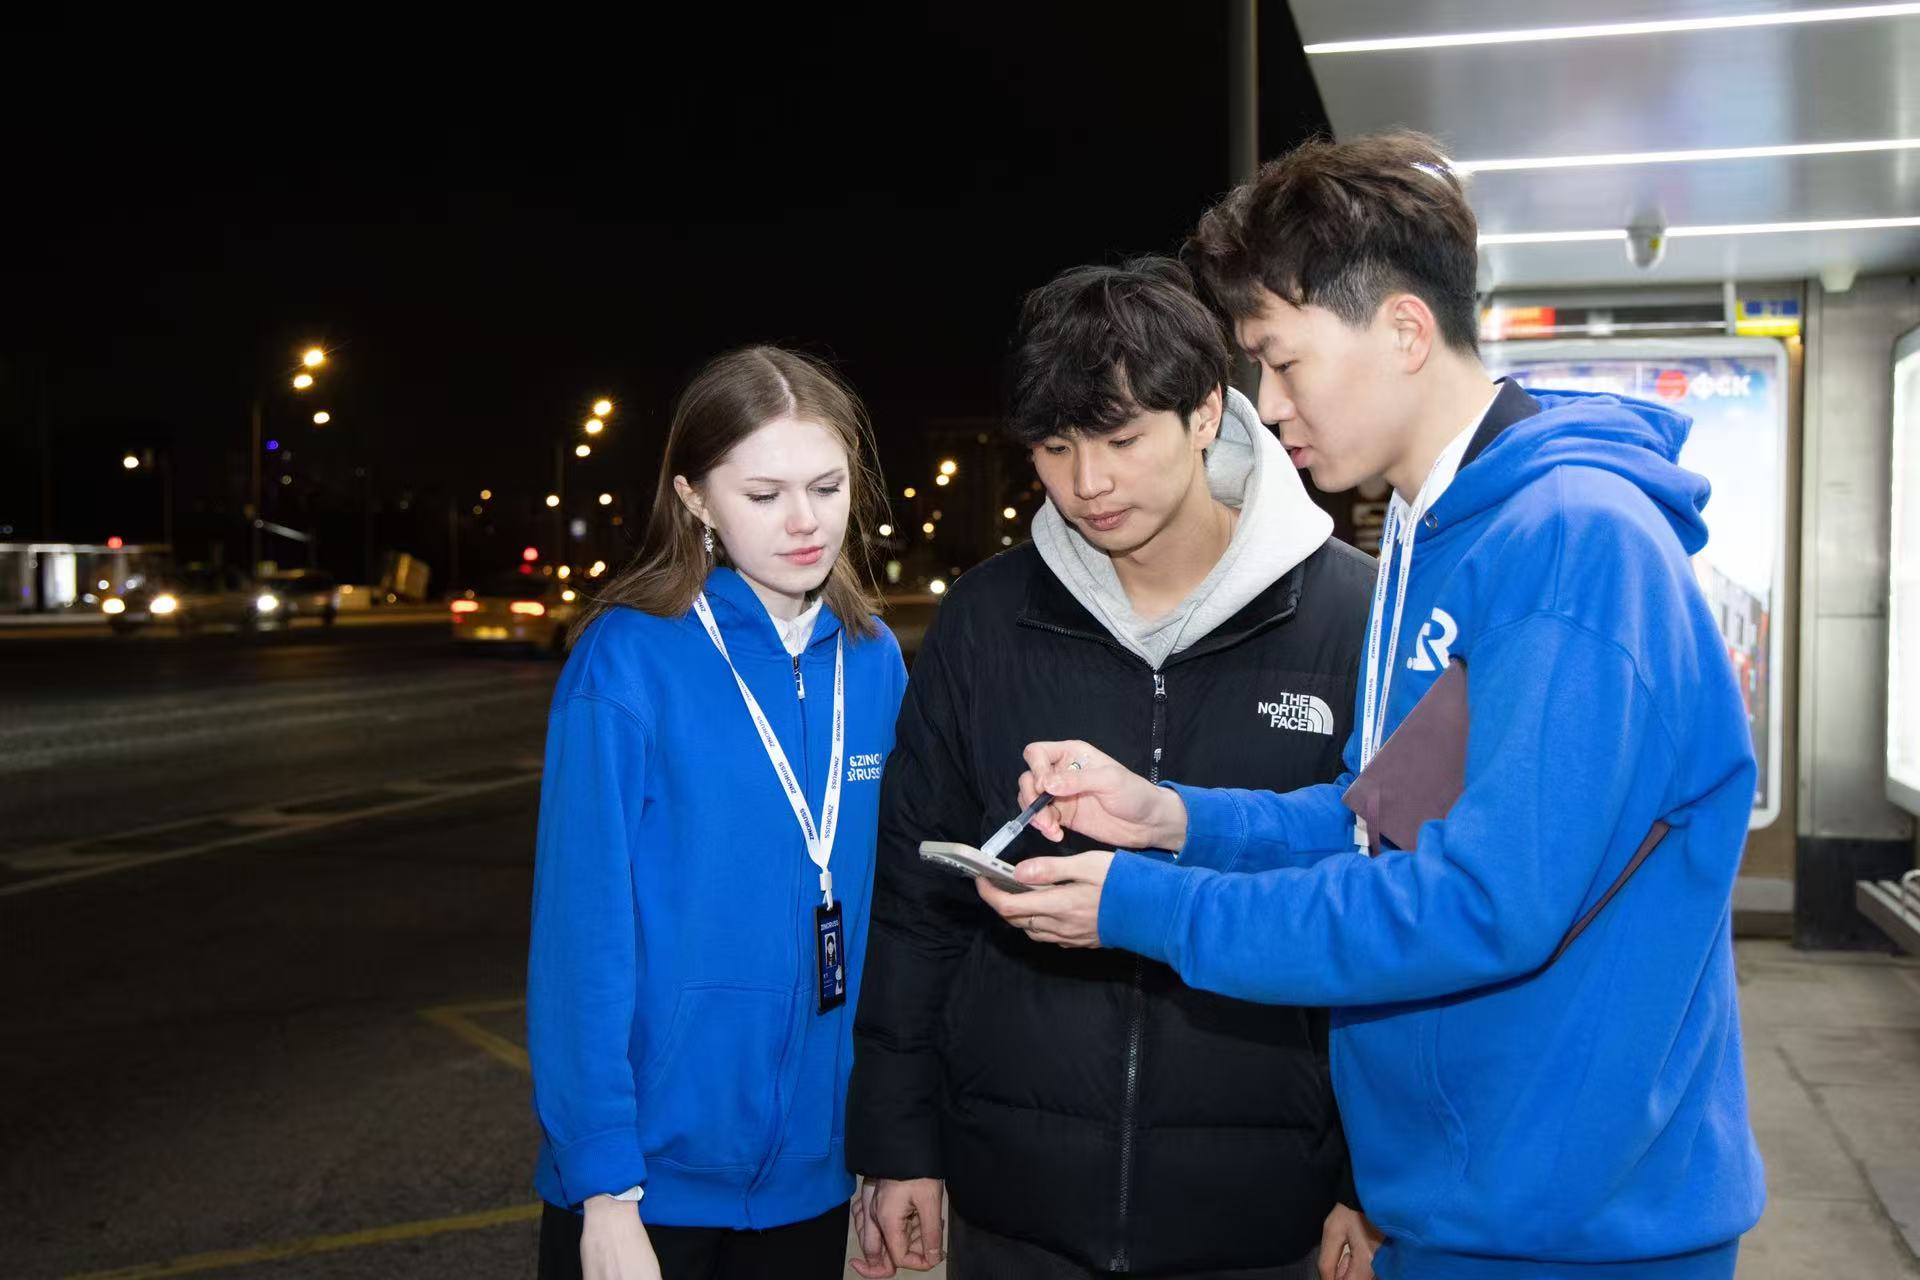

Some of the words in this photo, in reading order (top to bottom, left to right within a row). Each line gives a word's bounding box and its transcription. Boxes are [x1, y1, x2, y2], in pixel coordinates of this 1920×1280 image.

[1257, 702, 1309, 719] NORTH
[1280, 692, 1310, 707] THE
[1270, 715, 1308, 731] FACE
[778, 761, 796, 795] ZINORUSS
[831, 756, 840, 790] ZINORUSS
[800, 807, 814, 841] ZINORUSS
[824, 804, 834, 839] ZINORUSS
